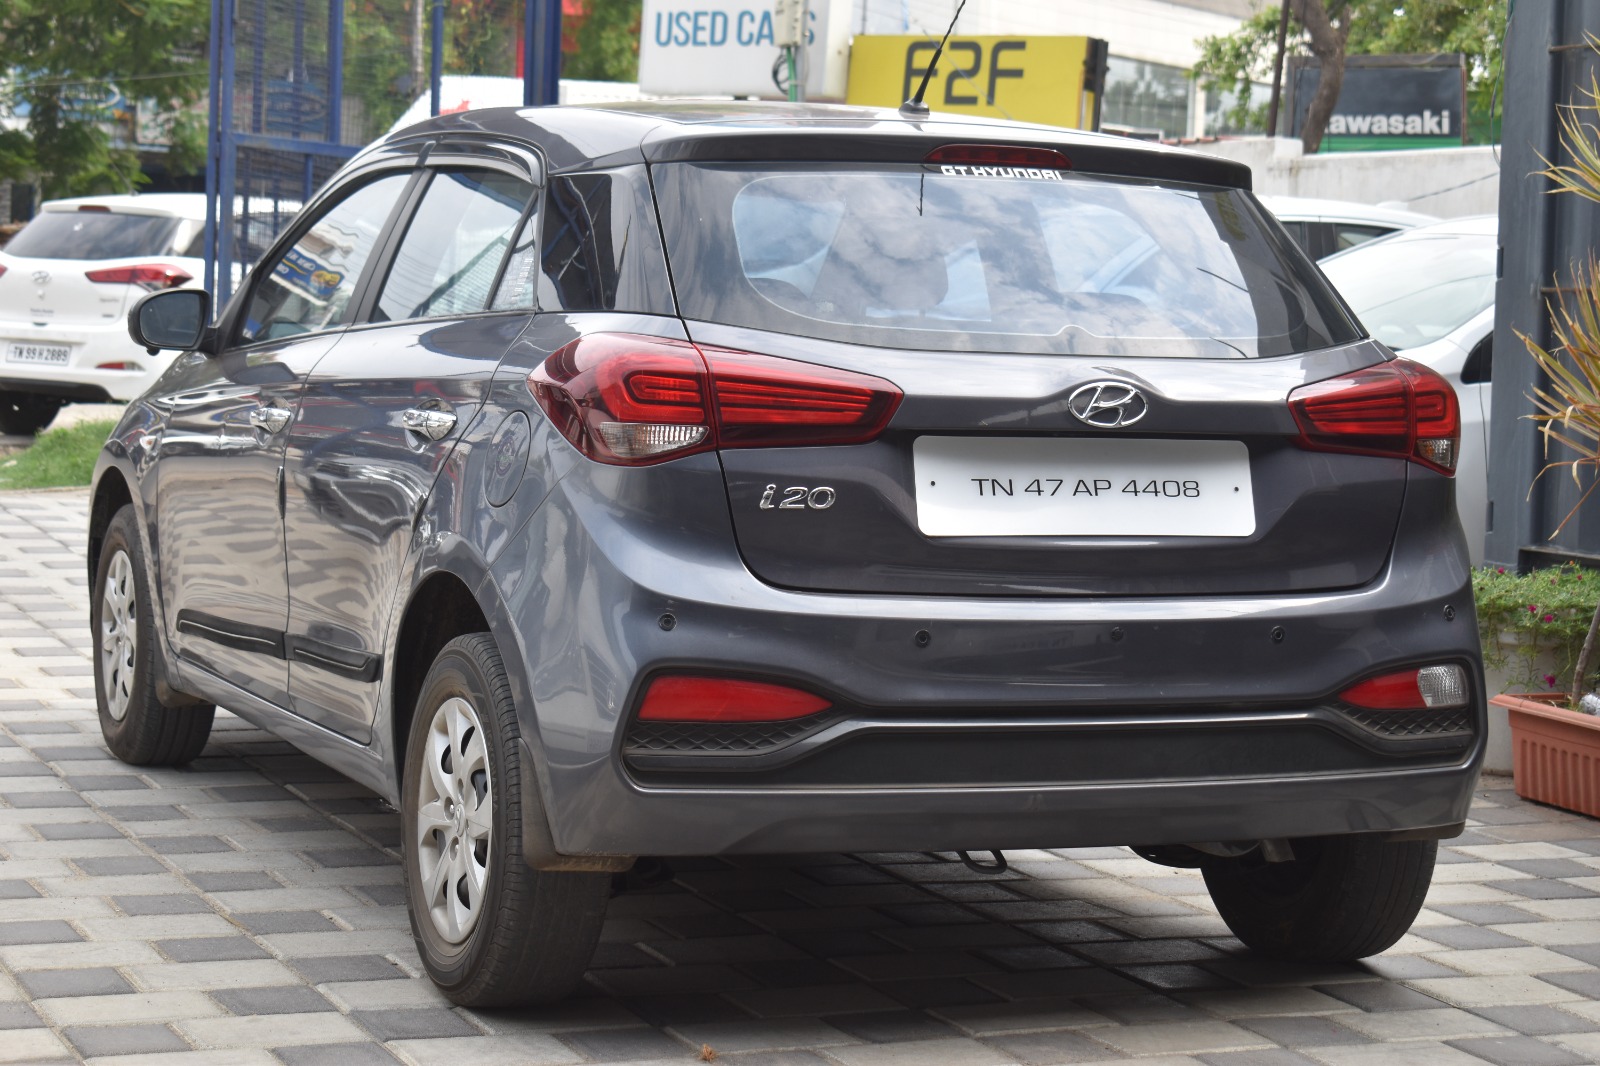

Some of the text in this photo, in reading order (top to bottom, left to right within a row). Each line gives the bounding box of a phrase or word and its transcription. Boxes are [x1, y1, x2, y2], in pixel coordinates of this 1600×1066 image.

[655, 10, 816, 48] USED CA
[902, 40, 1026, 106] F2F
[1323, 109, 1450, 135] awasaki
[940, 165, 1063, 181] GT HYUNDAI
[759, 484, 836, 510] i20
[970, 478, 1200, 498] TN 47 AP 4408
